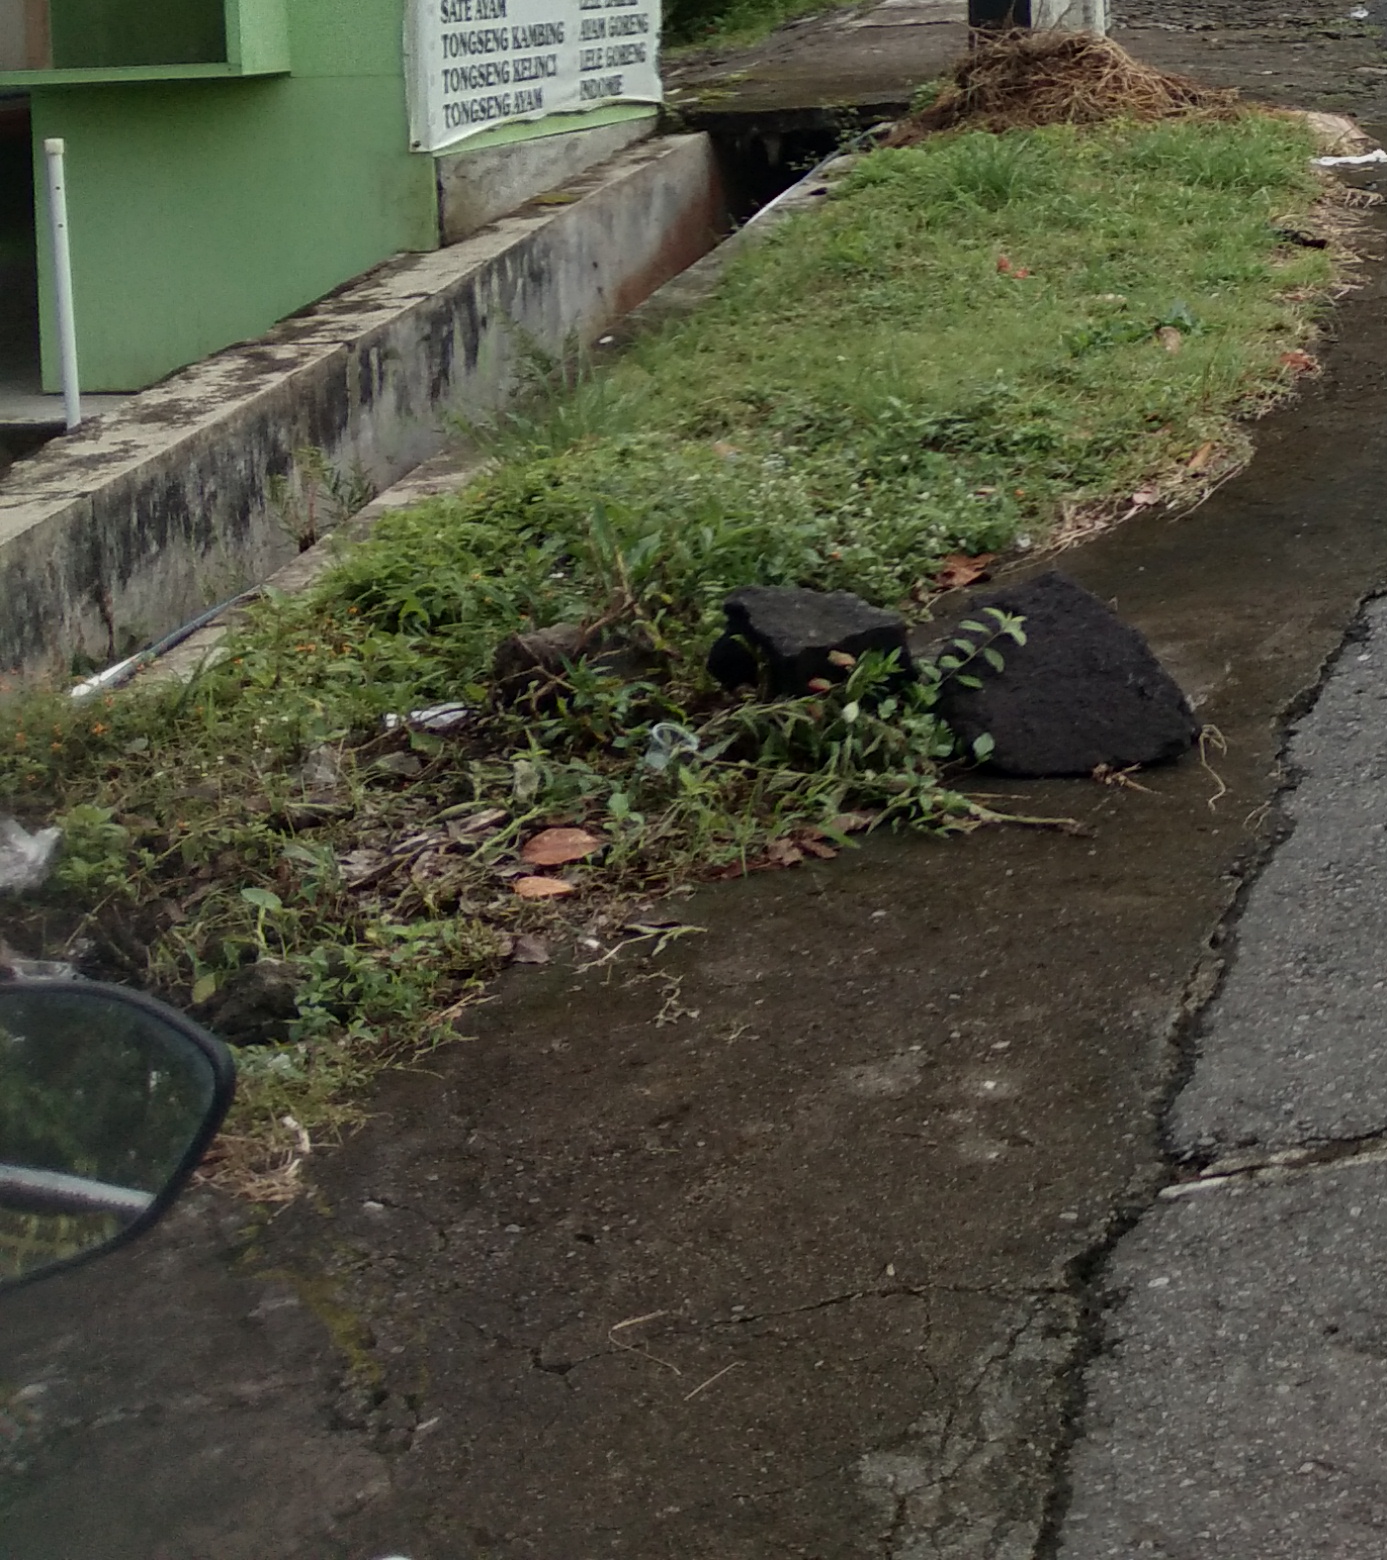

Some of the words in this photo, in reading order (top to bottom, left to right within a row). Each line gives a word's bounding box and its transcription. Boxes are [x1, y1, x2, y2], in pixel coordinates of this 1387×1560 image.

[441, 27, 509, 59] TONGSENG
[511, 21, 566, 50] KAMBING
[442, 59, 510, 94] TONGSENG
[512, 53, 558, 83] KELINCI
[442, 94, 511, 129] TONGSENG
[513, 88, 543, 115] AYAM
